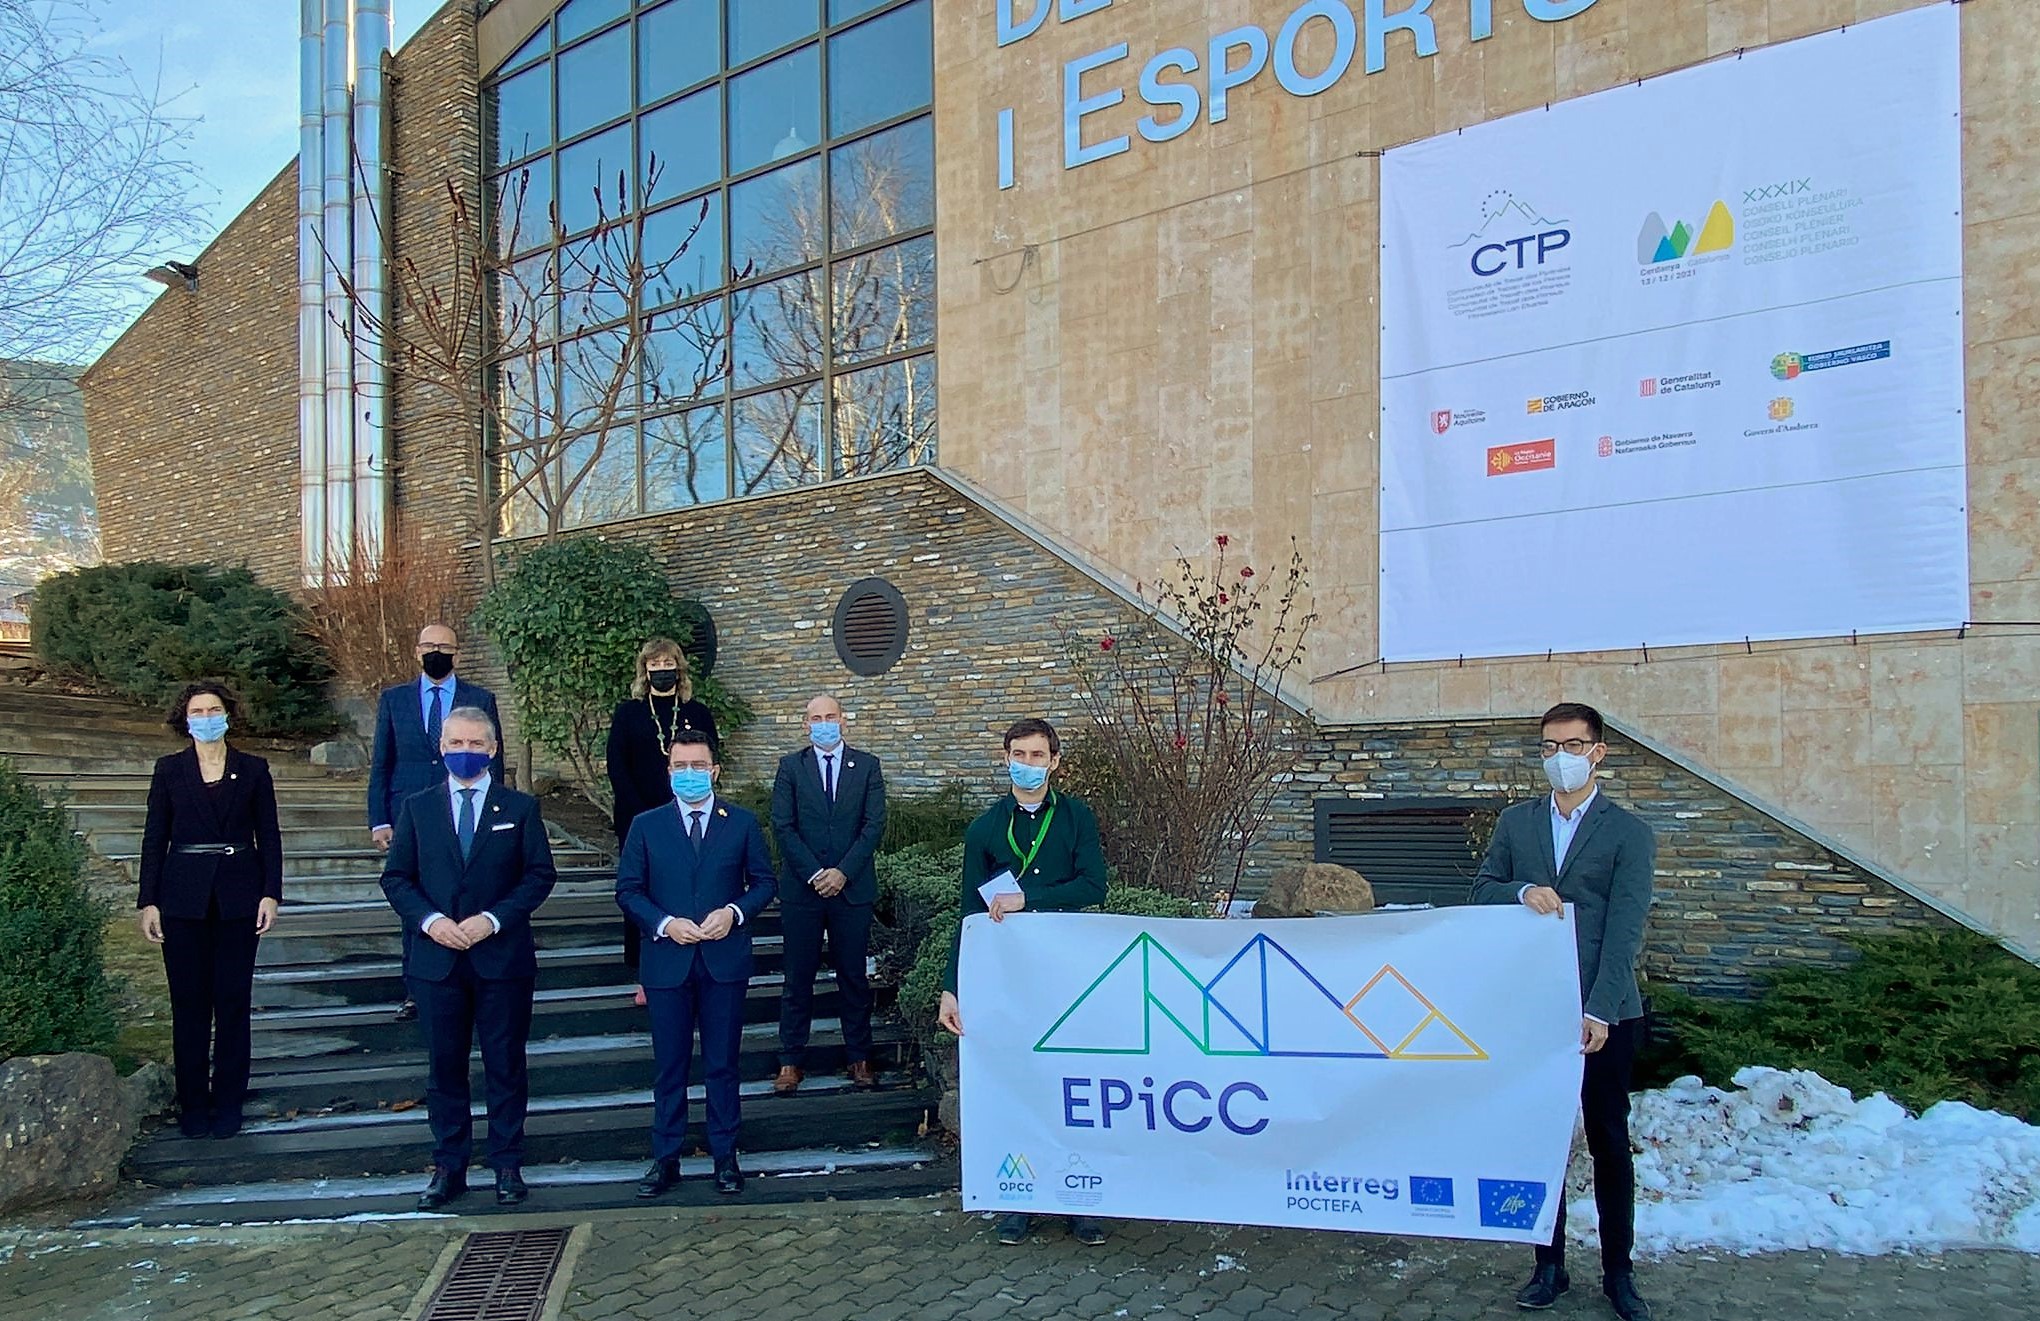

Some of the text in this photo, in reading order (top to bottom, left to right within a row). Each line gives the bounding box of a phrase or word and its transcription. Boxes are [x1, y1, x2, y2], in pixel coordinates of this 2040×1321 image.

[998, 0, 1600, 190] I ESPOR
[1743, 177, 1811, 204] XXXIX
[1798, 188, 1847, 206] PLENARI
[1800, 225, 1850, 243] PLENARI
[1471, 229, 1571, 277] CTP
[1744, 236, 1859, 265] CONSEJO PLENARIO
[1660, 371, 1711, 386] Generalitat
[1660, 379, 1721, 394] de Catalunya
[1543, 390, 1589, 405] GOBIERNO
[1543, 403, 1555, 412] DE
[1062, 1076, 1269, 1136] EPiCC
[999, 1182, 1033, 1192] OPCC
[1064, 1174, 1103, 1189] CTP
[1286, 1169, 1399, 1200] Interreg
[1287, 1197, 1363, 1214] POCTEFA
